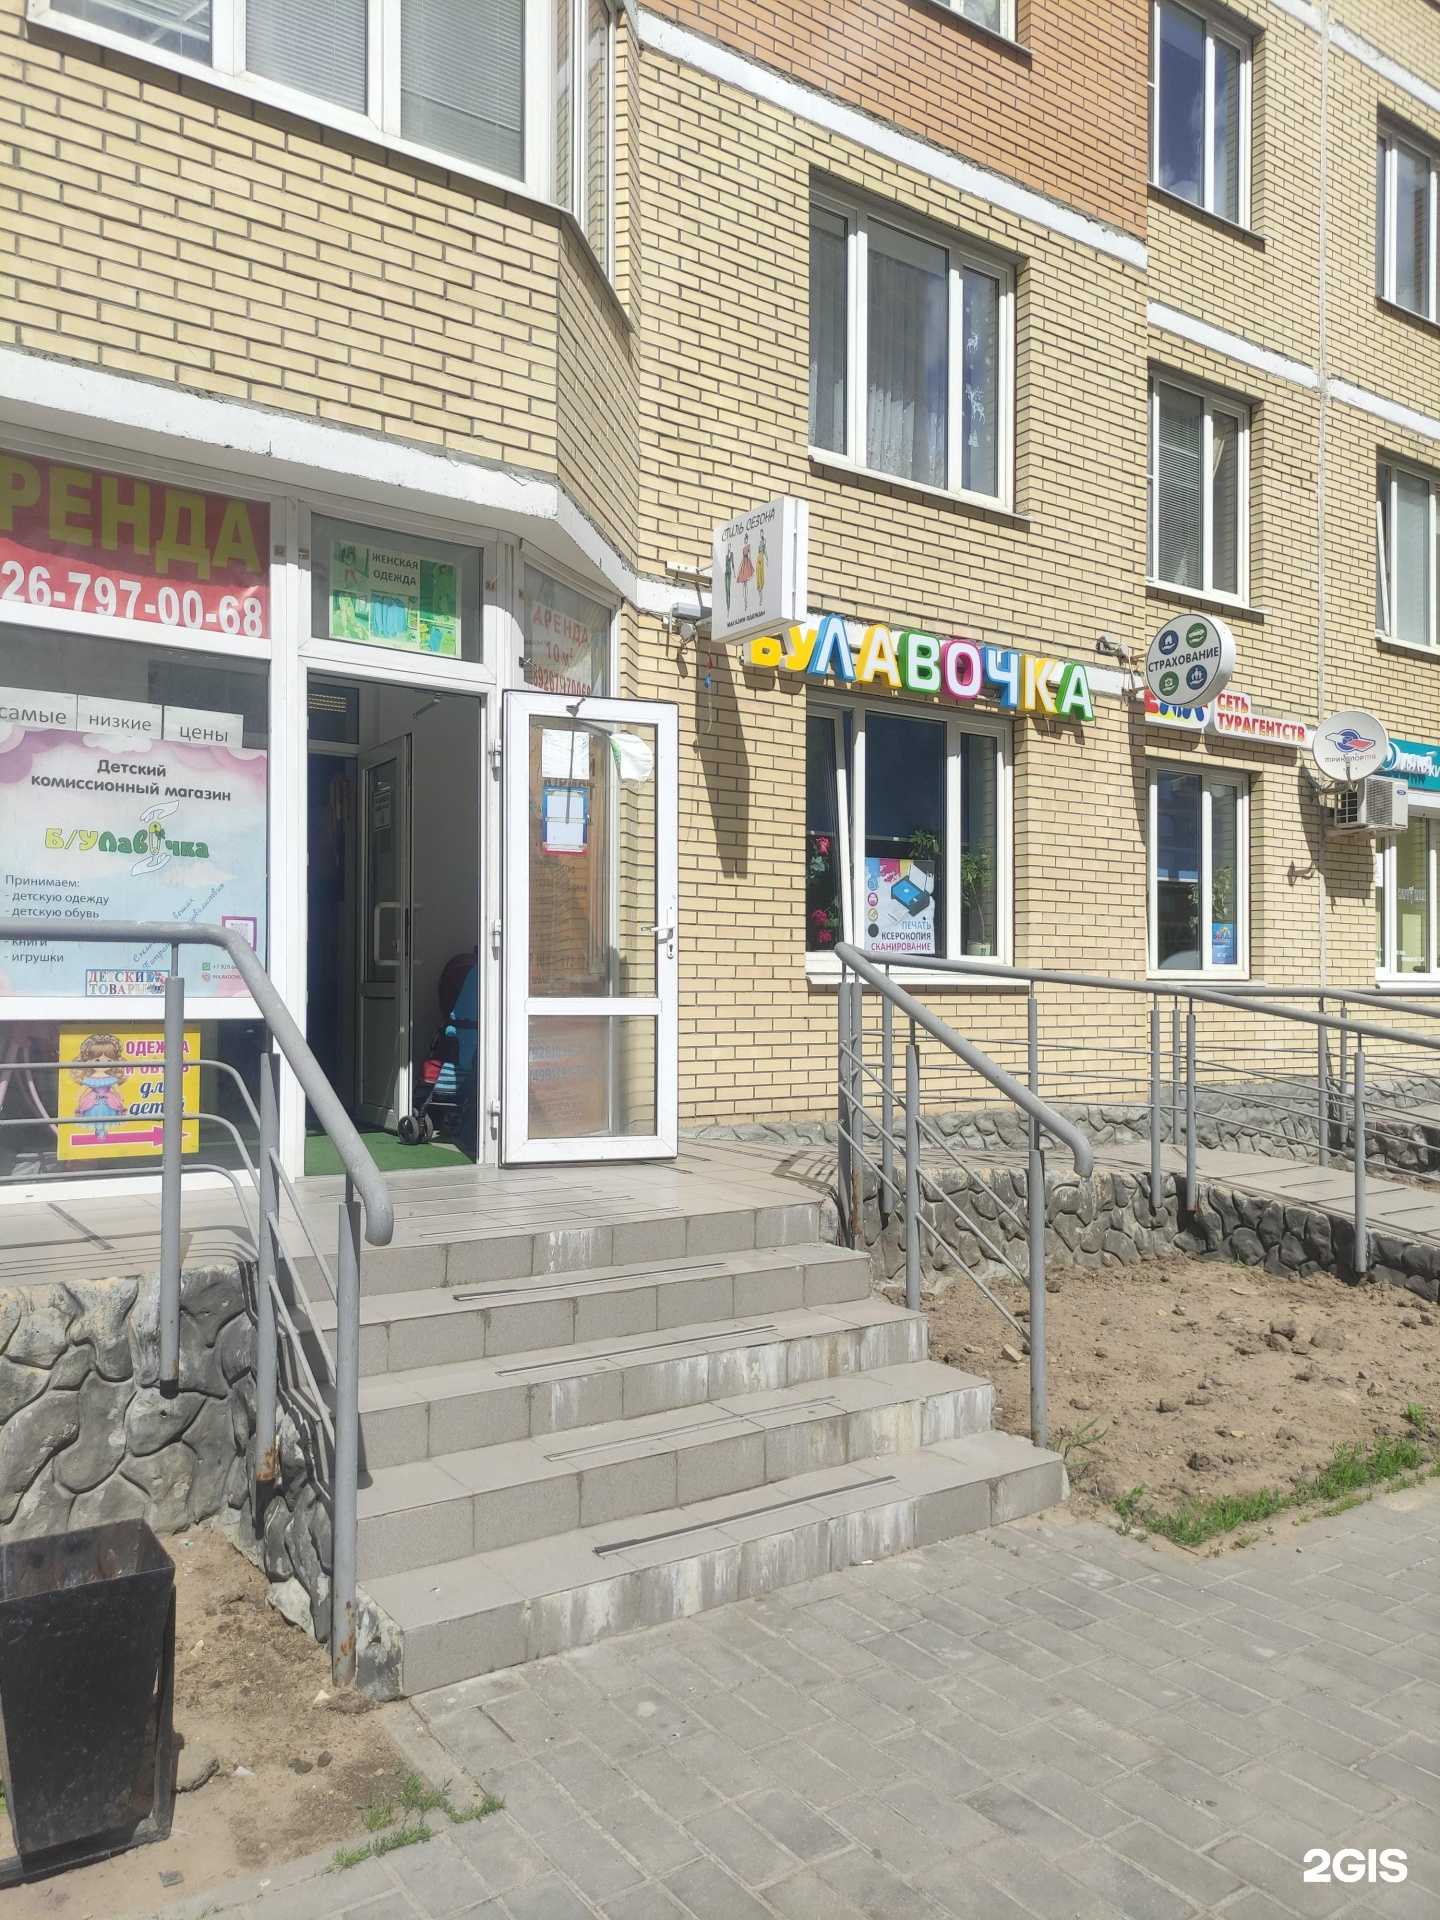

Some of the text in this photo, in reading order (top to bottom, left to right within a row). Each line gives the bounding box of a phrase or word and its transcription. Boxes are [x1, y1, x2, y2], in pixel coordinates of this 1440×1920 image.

[721, 507, 776, 542] СТИЛЬ СЕЗОНА
[372, 553, 419, 570] ЖЕНСКАЯ
[373, 570, 417, 586] ОДЕЖДА
[0, 560, 263, 638] 26-797-00-68
[532, 606, 590, 646] АРЕНДА
[1148, 647, 1220, 673] СТРАХОВАНИЕ
[1217, 693, 1249, 713] СЕТЬ
[0, 706, 229, 743] самые низкие цены
[1217, 713, 1305, 742] ТУРАГЕНТСТВ
[97, 760, 167, 777] Детский
[31, 775, 231, 801] комиссионный магазин
[5, 875, 80, 888] Принимаем:
[12, 892, 62, 903] детскую
[65, 894, 109, 905] одежду
[12, 907, 62, 918] детскую
[65, 909, 100, 919] обувь
[902, 920, 932, 930] ПЕЧАТЬ
[12, 937, 48, 946] книги
[881, 931, 931, 941] КСЕРОКОПИЯ
[871, 942, 932, 951] СКАНИРОВАНИЕ
[12, 953, 64, 964] игрушки
[126, 1041, 189, 1056] ОДЕЖА
[129, 1102, 185, 1116] дет
